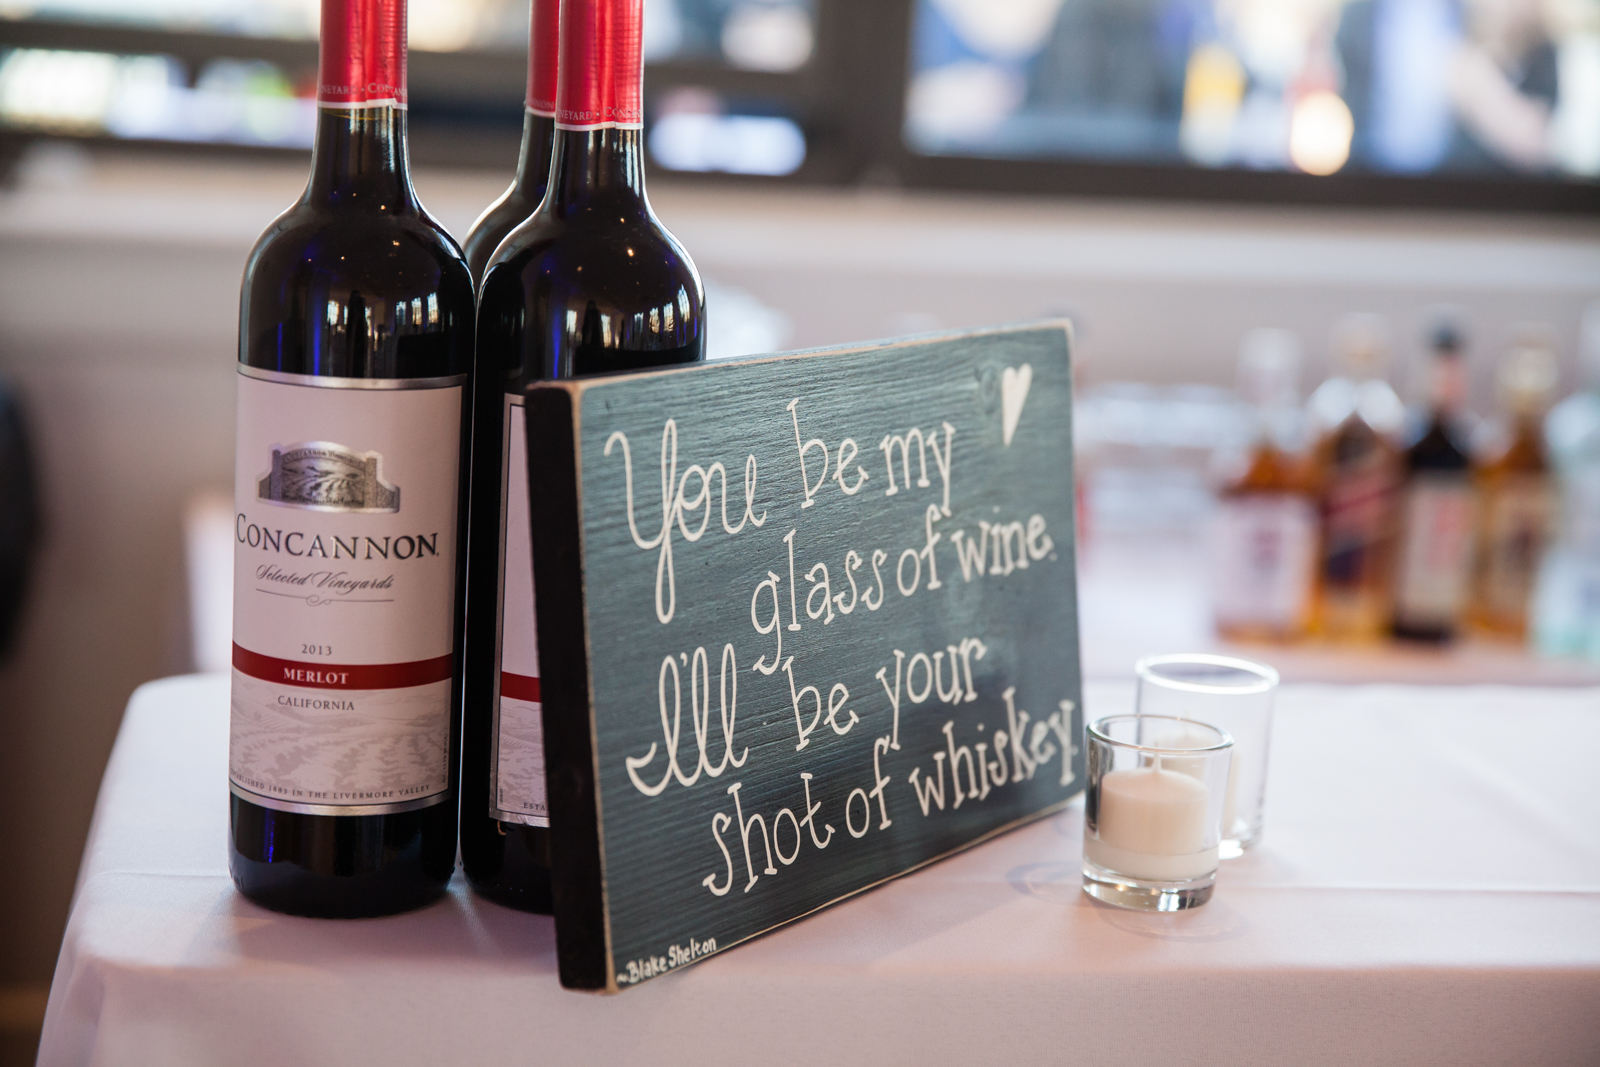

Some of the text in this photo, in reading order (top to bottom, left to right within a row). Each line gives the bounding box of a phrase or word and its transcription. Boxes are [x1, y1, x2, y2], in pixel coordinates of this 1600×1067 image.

[604, 398, 956, 624] You be my
[255, 564, 394, 596] Selected Vineyards
[751, 528, 888, 674] glass
[897, 504, 942, 597] of
[301, 644, 333, 656] 2013
[283, 667, 349, 685] MERLOT
[277, 695, 355, 711] CALIFORNIA
[626, 637, 987, 797] I'll be your
[268, 784, 288, 795] 1883
[292, 789, 303, 797] IN
[308, 791, 328, 799] THE
[333, 790, 394, 800] LIVERMORE
[398, 784, 430, 796] VALLEY
[523, 802, 546, 811] ESTA
[702, 773, 835, 897] shot
[845, 735, 893, 838] of
[668, 937, 717, 968] Shelton
